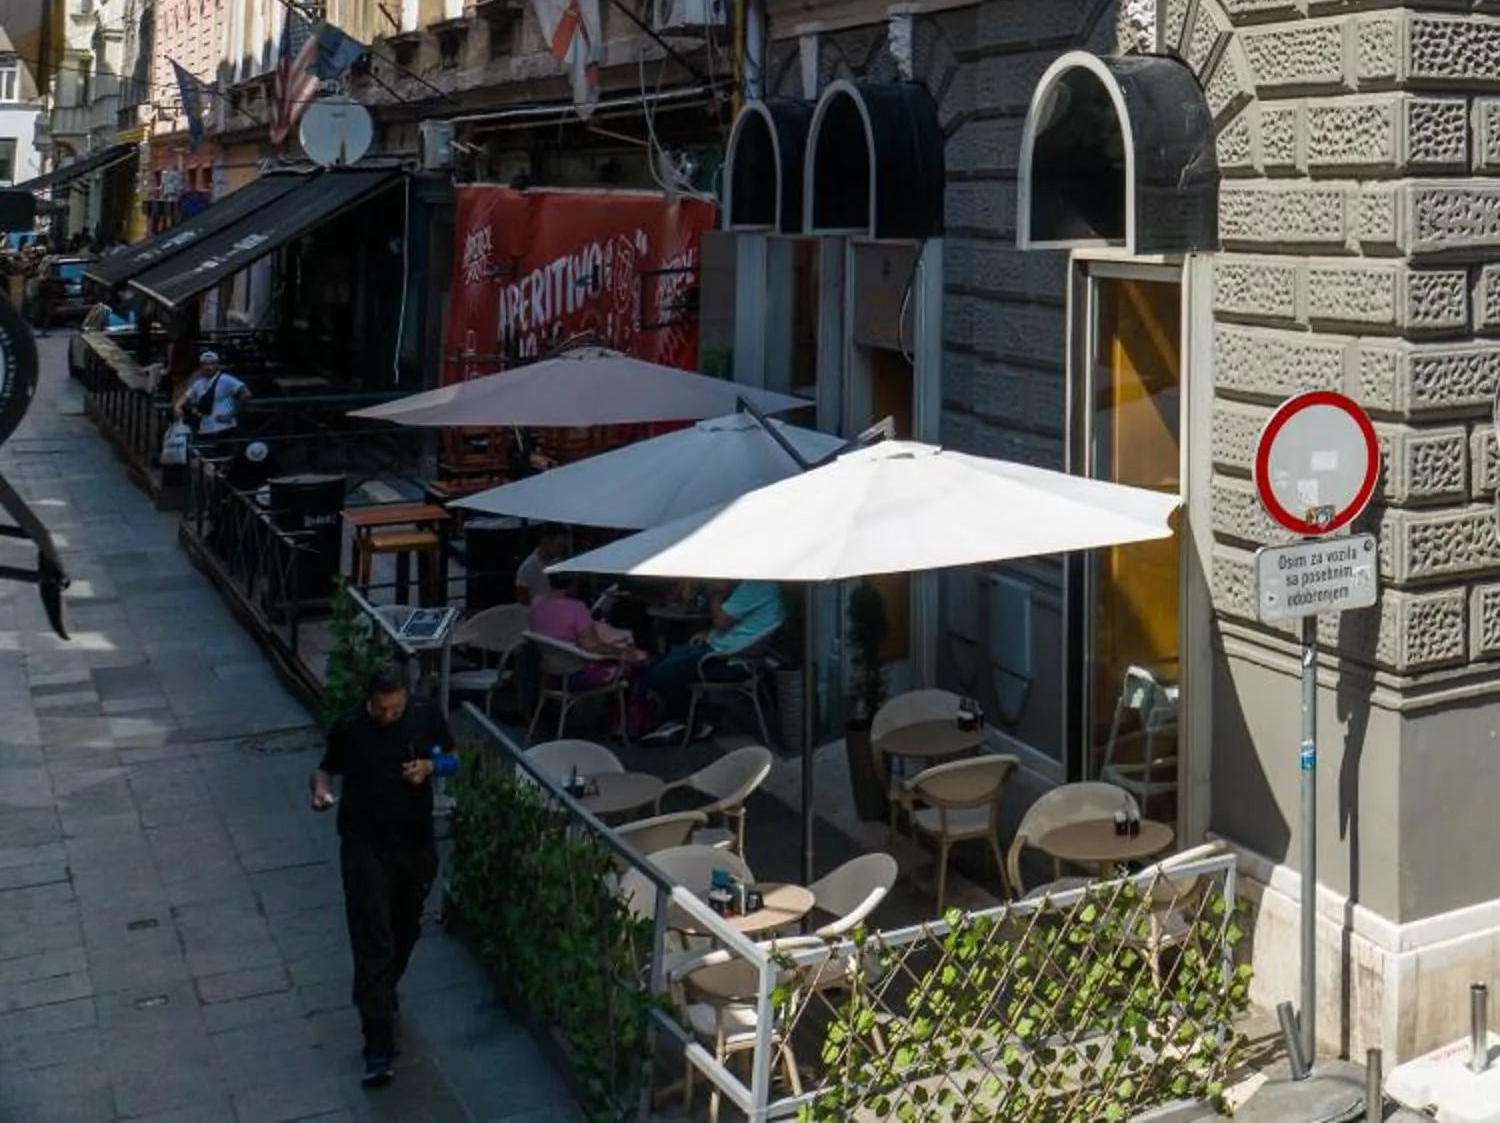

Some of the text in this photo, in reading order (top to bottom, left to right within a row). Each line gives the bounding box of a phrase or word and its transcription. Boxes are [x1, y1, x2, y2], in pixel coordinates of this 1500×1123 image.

[1278, 544, 1357, 570] Osim za vozila
[1286, 565, 1353, 588] sa posebnim
[1287, 586, 1349, 607] odobrenjem
